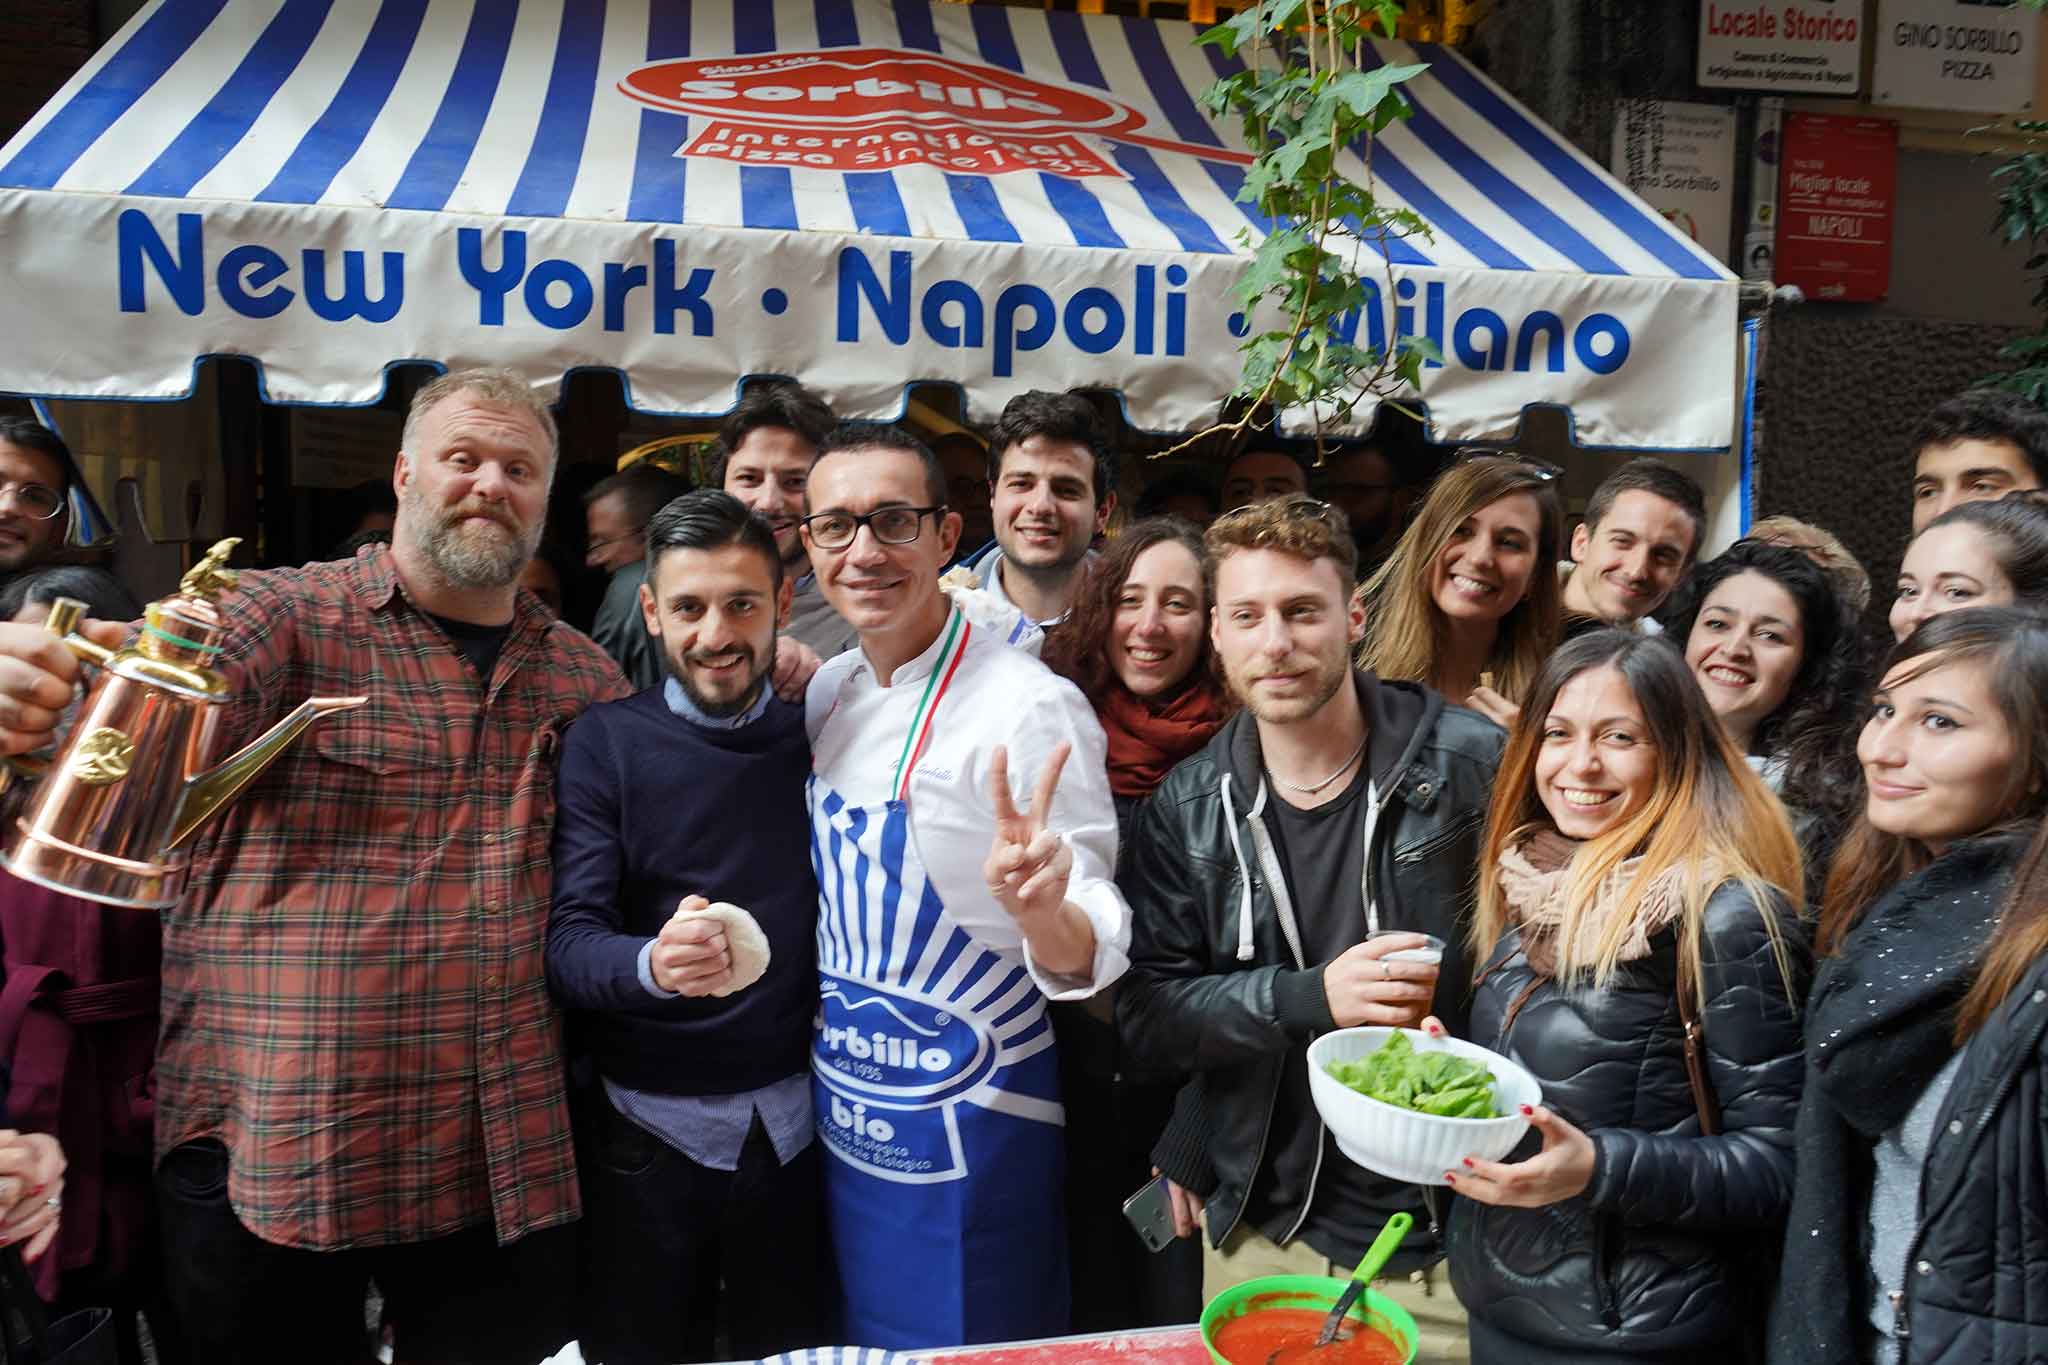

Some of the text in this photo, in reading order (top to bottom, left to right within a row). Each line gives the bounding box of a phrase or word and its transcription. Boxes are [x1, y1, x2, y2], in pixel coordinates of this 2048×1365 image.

[1707, 3, 1857, 42] Locale Storico
[1894, 21, 2023, 55] GINO SORBILLO
[1941, 60, 1997, 80] PIZZA
[680, 77, 1062, 116] Sorbillo
[695, 143, 836, 164] Pizza
[855, 147, 980, 169] since
[715, 128, 1077, 157] International
[1663, 173, 1721, 191] Sorbillo
[1807, 215, 1863, 238] NAPOLI
[118, 209, 404, 324] New
[458, 228, 716, 337] York
[836, 246, 1188, 378] Napoli
[821, 1026, 952, 1073] rbillo
[831, 1095, 895, 1142] bio
